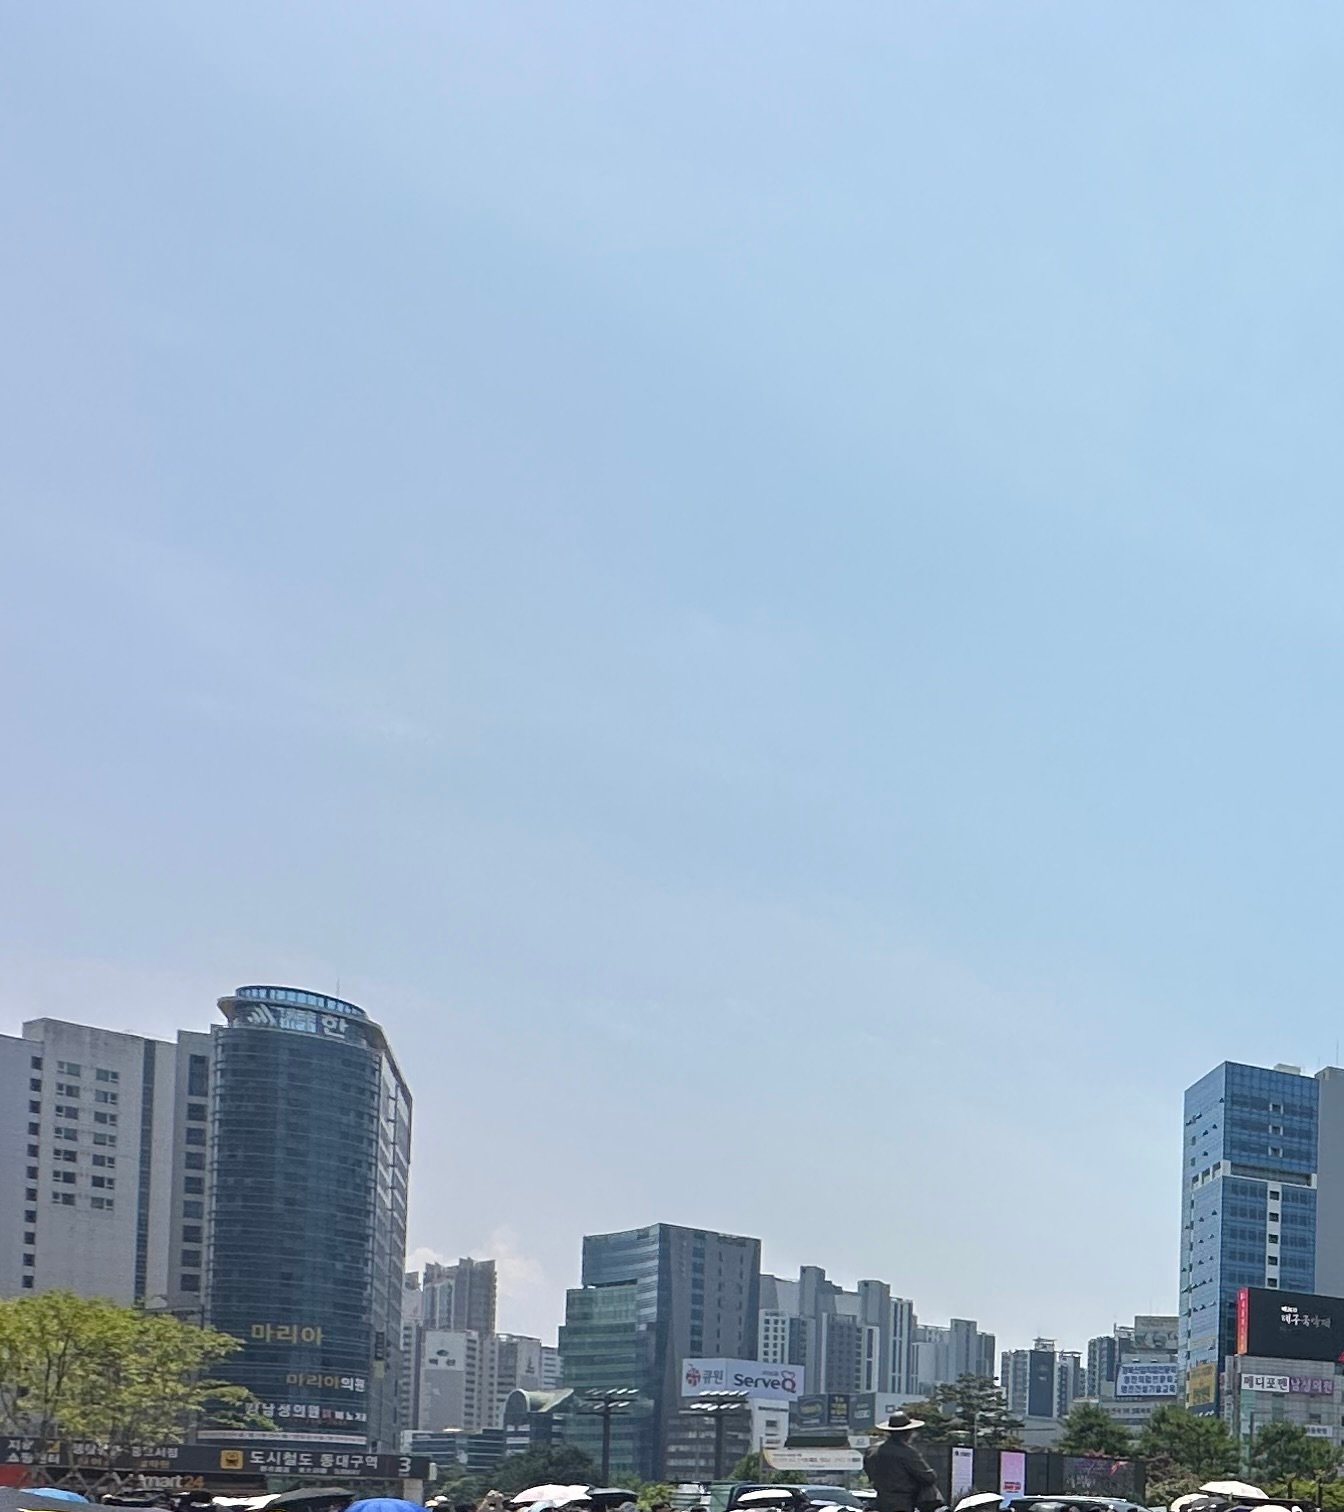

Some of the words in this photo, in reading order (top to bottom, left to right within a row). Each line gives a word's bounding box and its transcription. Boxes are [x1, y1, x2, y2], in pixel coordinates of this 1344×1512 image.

[251, 1323, 323, 1345] 마리아
[286, 1374, 365, 1392] 마리아의원
[702, 1370, 724, 1385] 큐원
[734, 1373, 797, 1393] ServeQ
[1290, 1377, 1333, 1393] 남성의원
[249, 1450, 313, 1466] 도시철도
[320, 1453, 378, 1469] 동대구역
[398, 1457, 411, 1472] 3
[131, 1474, 205, 1488] mart24
